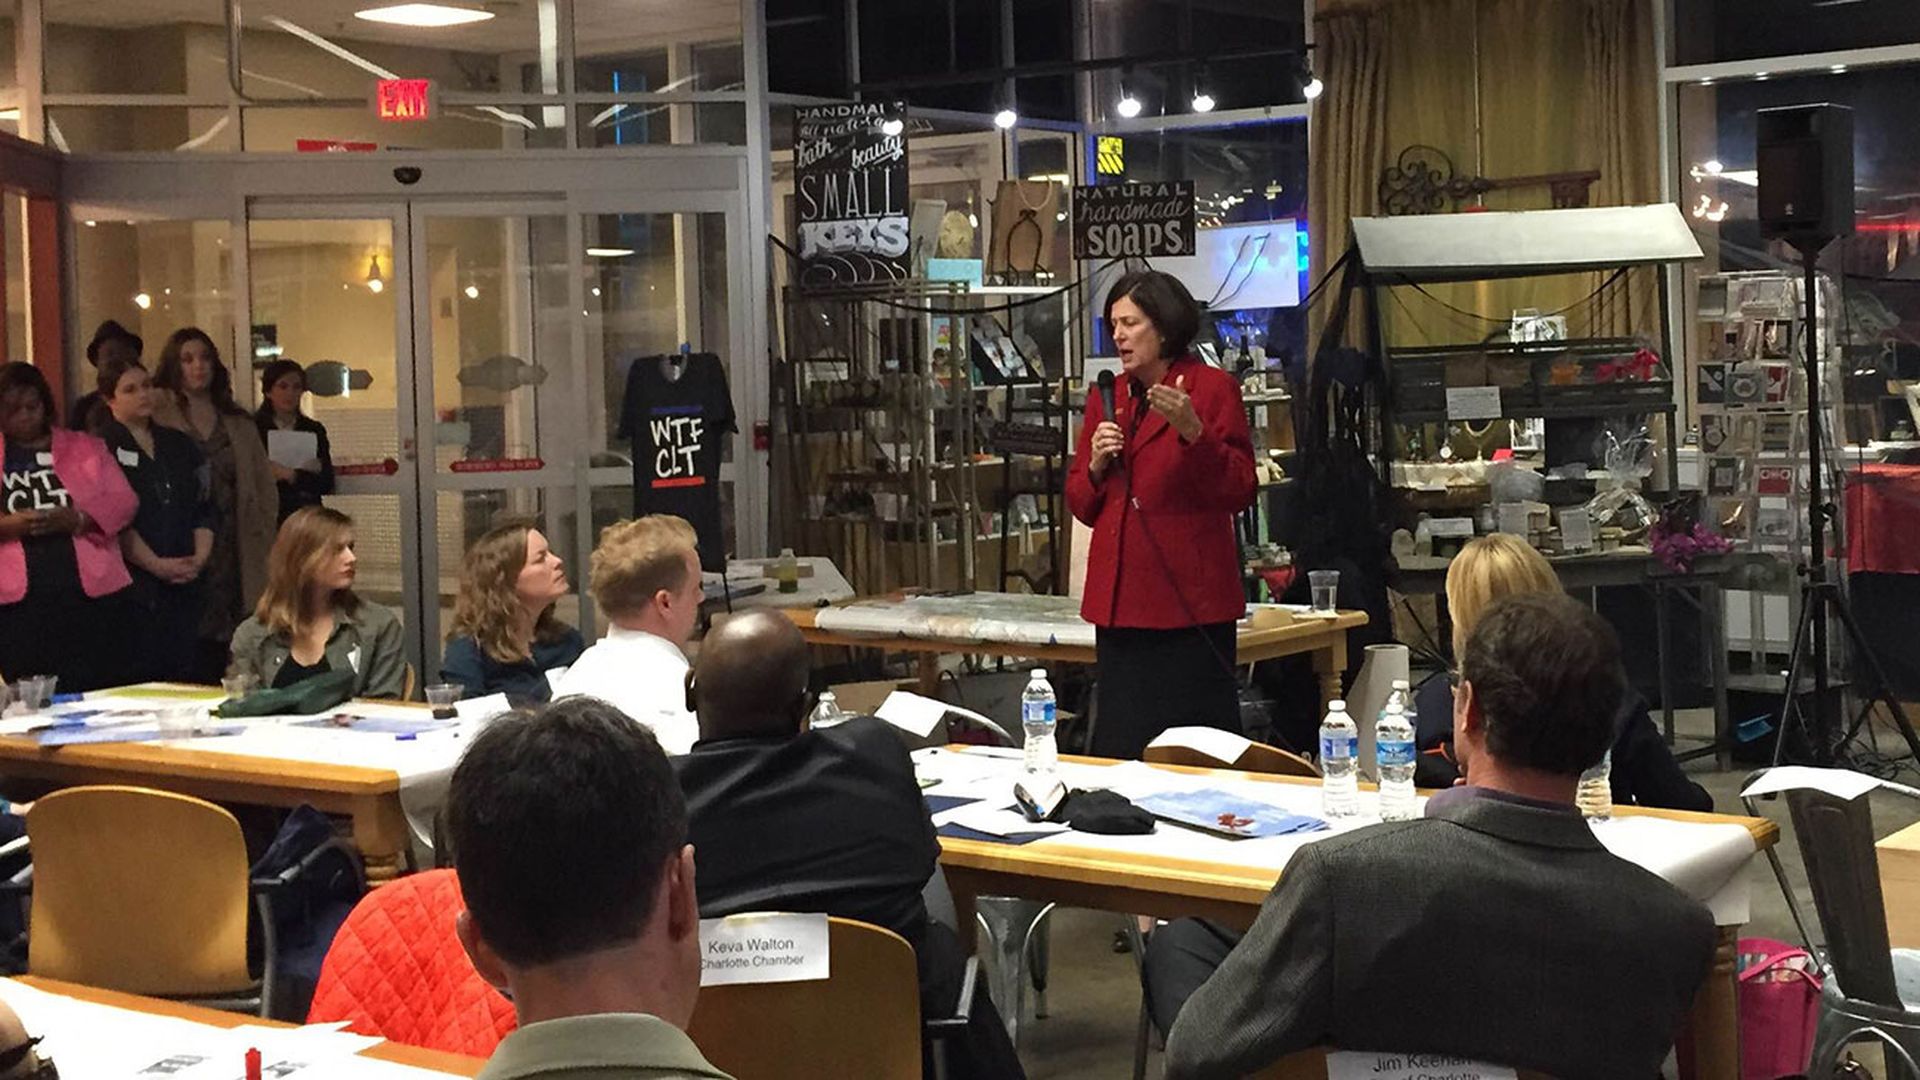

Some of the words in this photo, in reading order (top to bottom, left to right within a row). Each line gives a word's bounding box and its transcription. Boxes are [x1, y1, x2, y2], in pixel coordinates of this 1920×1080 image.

[380, 82, 427, 117] EXIT
[796, 102, 904, 119] HANDMA
[823, 116, 888, 137] natura
[795, 136, 836, 168] bath
[851, 136, 904, 169] beauty
[800, 166, 904, 220] SMALL
[1075, 183, 1187, 199] NATURAL
[1080, 196, 1190, 222] handmade
[798, 217, 909, 259] KEYS
[650, 416, 704, 446] WTF
[656, 444, 701, 478] CLT
[3, 470, 55, 490] WT
[8, 488, 68, 514] CLT
[708, 940, 743, 954] Keva
[747, 938, 794, 952] Walton
[700, 956, 750, 971] Charlotte
[752, 955, 804, 968] Chamber
[1373, 1055, 1402, 1072] Jim
